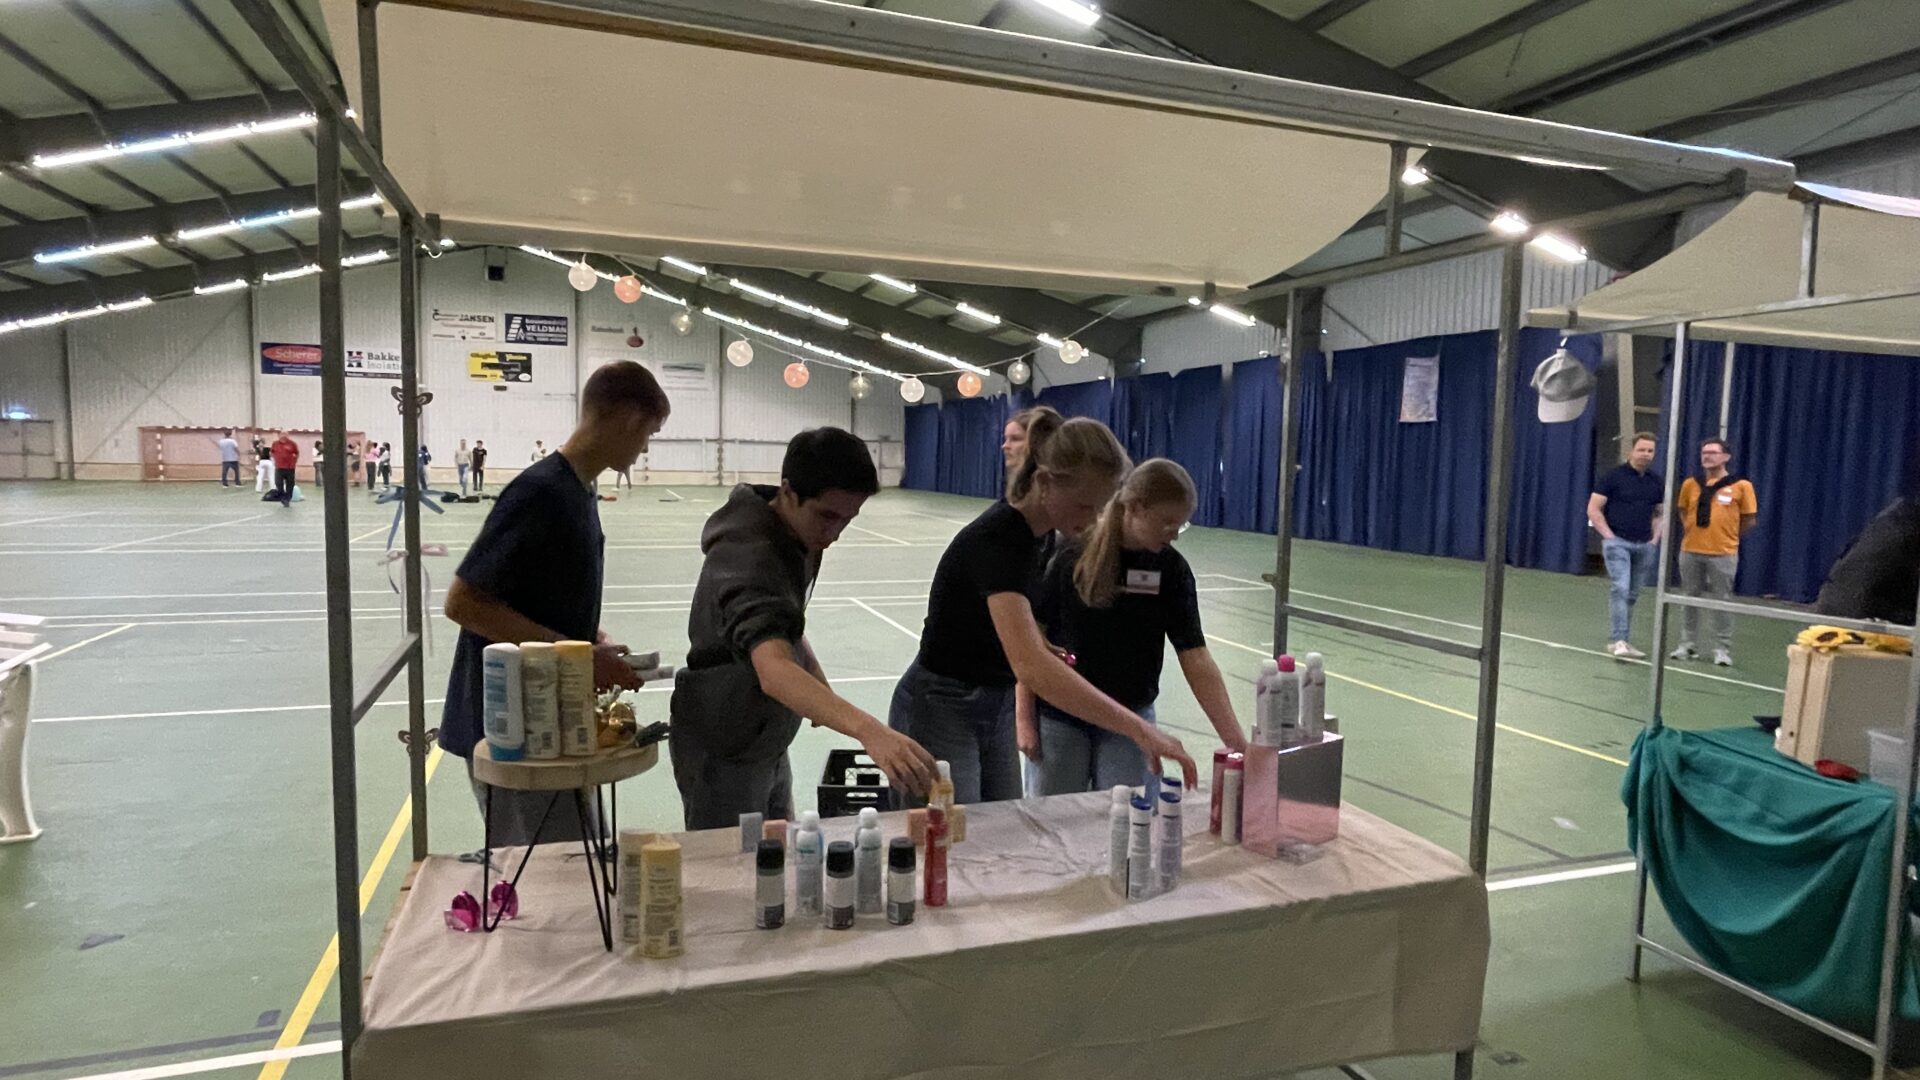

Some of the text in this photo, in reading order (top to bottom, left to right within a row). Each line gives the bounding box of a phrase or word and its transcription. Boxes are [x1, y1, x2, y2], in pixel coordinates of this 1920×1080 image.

[459, 314, 495, 323] JANSEN
[525, 324, 567, 333] VELDMAN
[367, 352, 400, 361] Bakke
